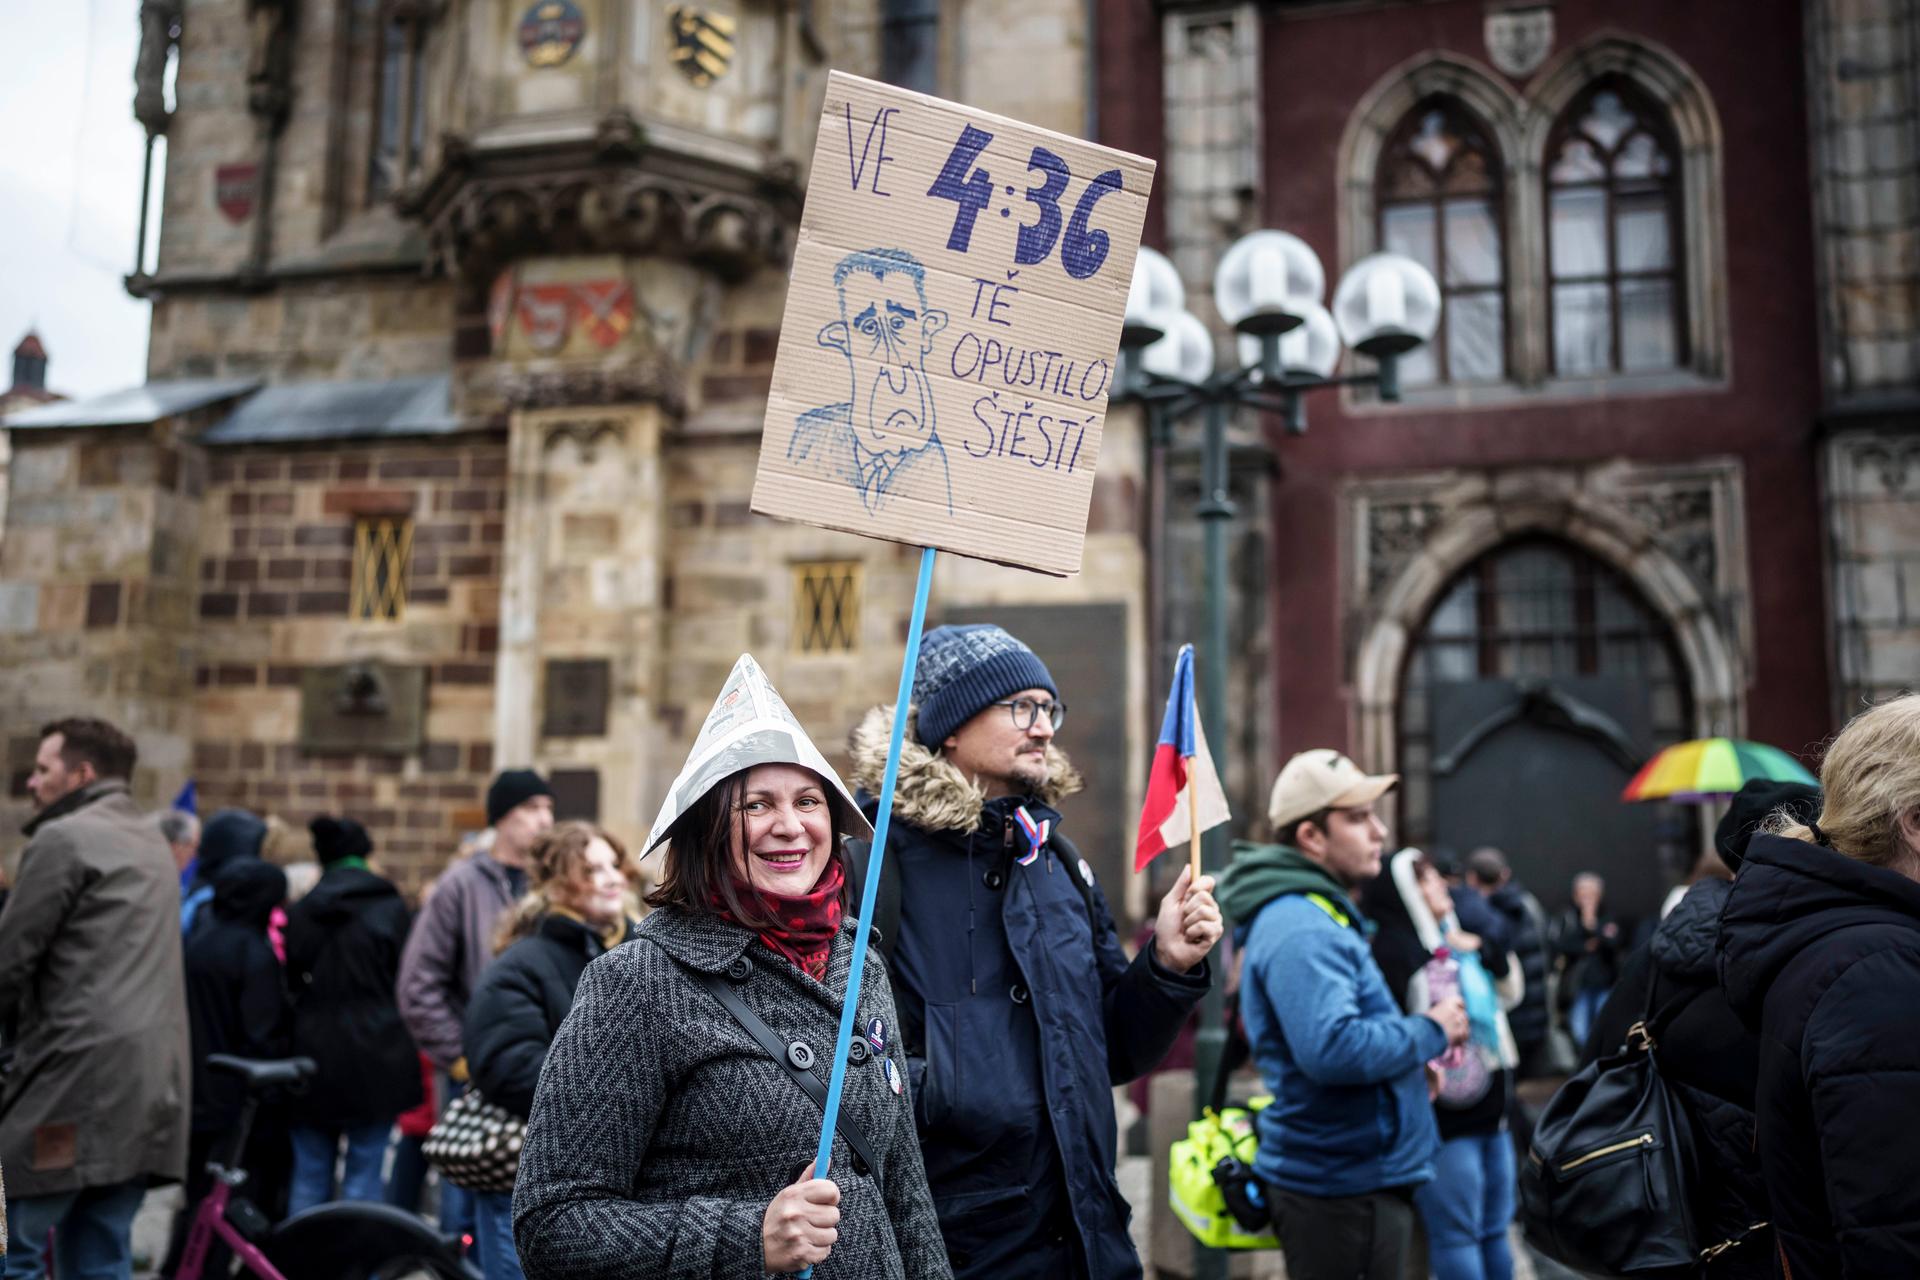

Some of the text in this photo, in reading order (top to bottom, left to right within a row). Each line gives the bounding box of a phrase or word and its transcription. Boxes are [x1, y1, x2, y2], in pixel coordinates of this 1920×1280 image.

[846, 102, 1124, 280] VE 4:36
[970, 270, 1020, 327] TĚ
[951, 332, 1108, 400] OPUSTILO
[964, 391, 1096, 474] ŠTĚSTÍ
